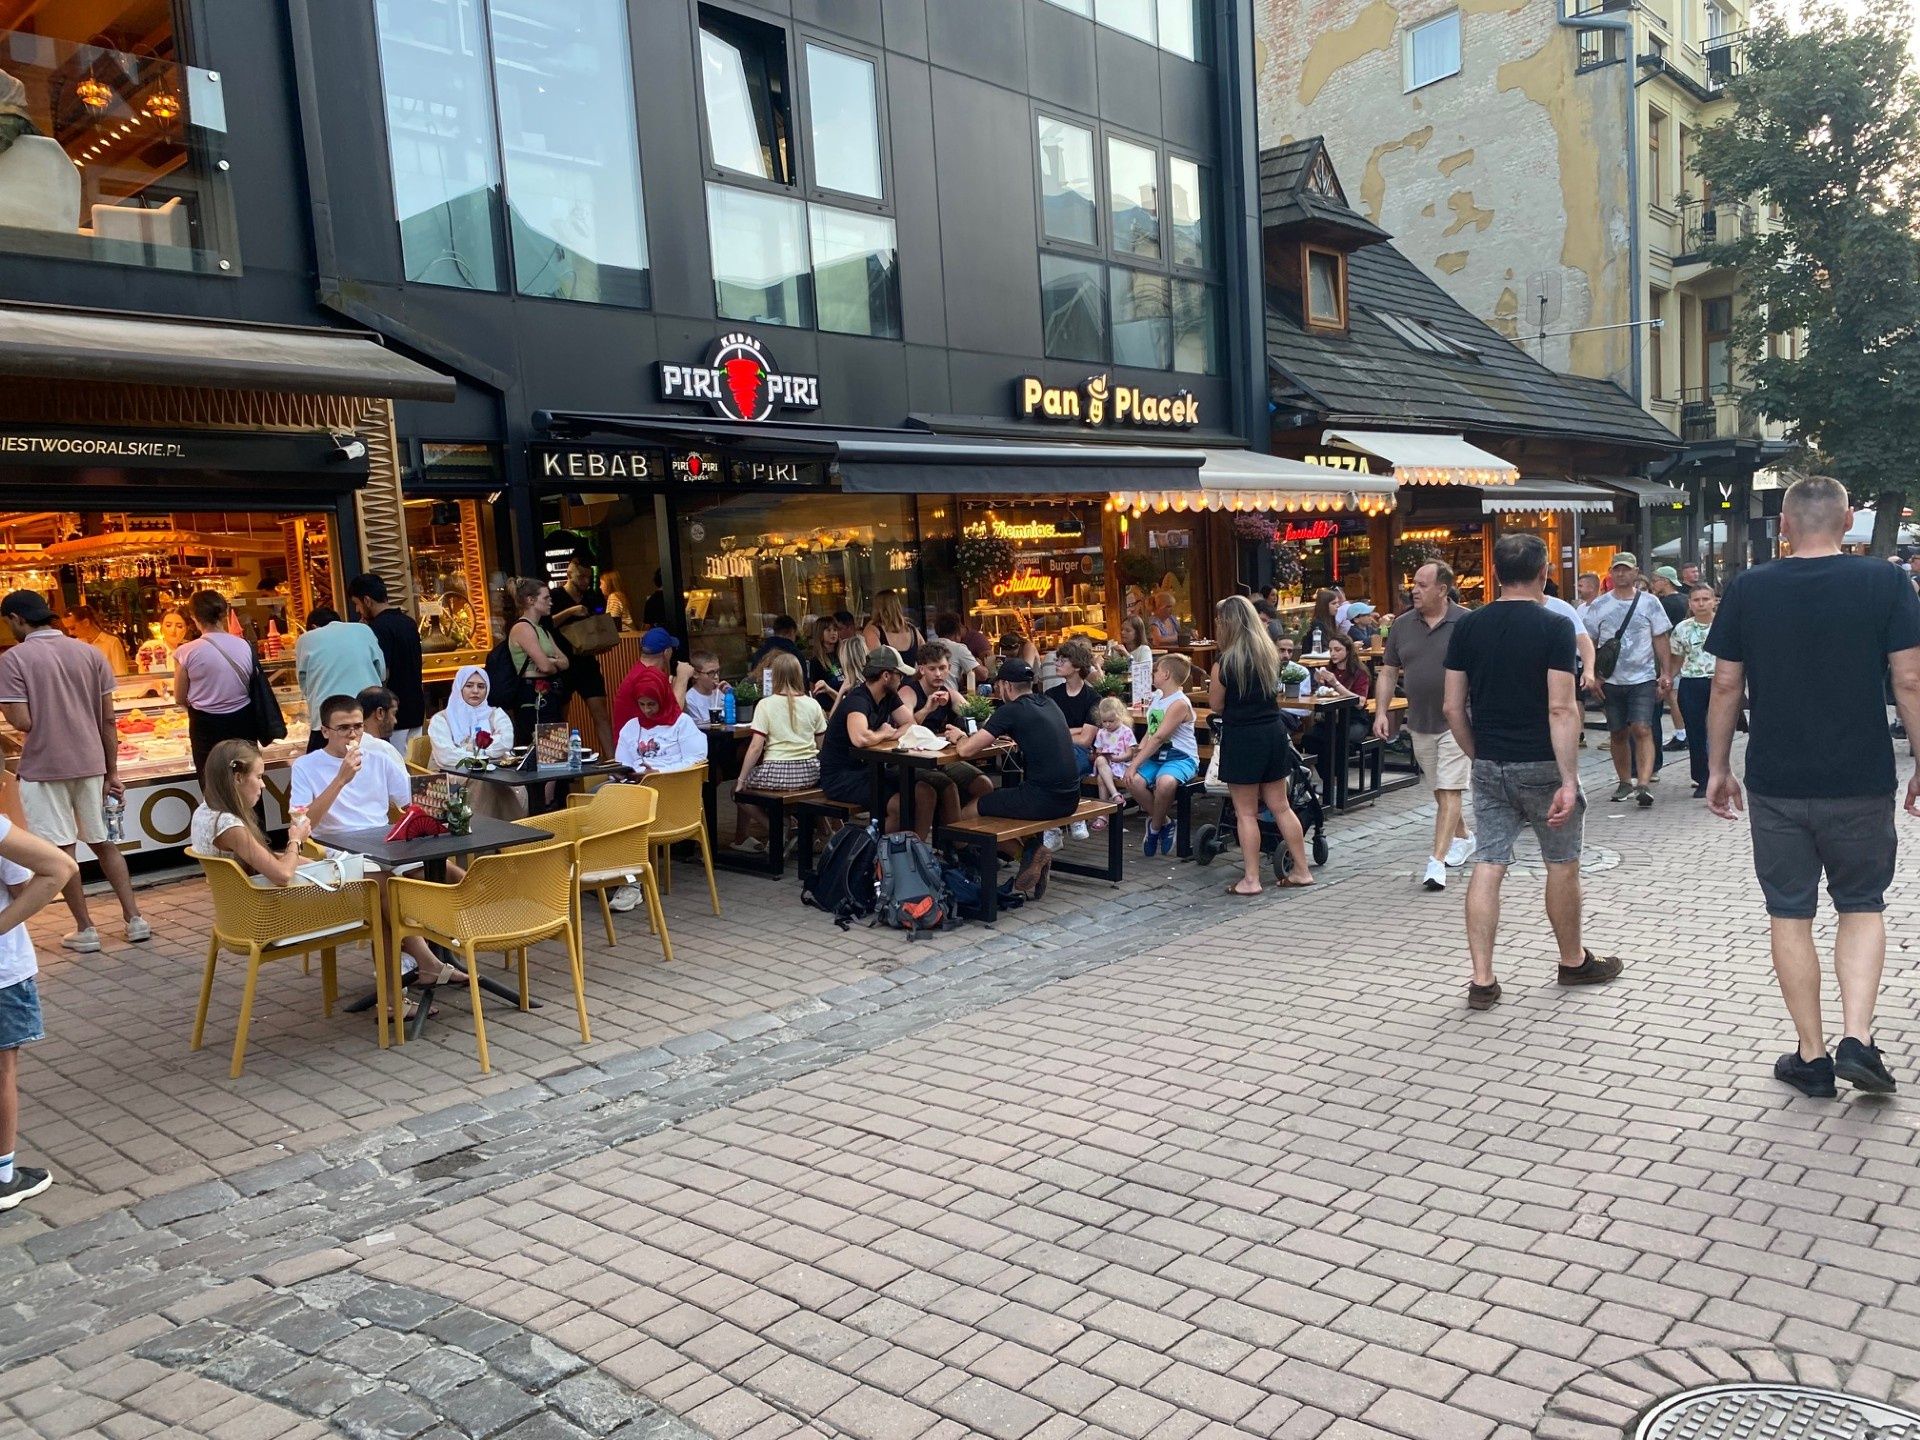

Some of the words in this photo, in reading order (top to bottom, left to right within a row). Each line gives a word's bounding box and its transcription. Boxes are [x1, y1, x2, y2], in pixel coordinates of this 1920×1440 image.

[720, 333, 761, 350] KEBAB
[663, 365, 722, 398] PIRI
[767, 374, 819, 405] PIRI
[1024, 378, 1080, 416] Pan
[1115, 387, 1199, 424] Placek
[0, 437, 186, 457] IESTWOGORALSKIE.PL
[543, 452, 648, 477] KEBAB
[672, 461, 689, 472] PIRI
[702, 462, 718, 472] PIRI
[1049, 559, 1079, 573] Burger
